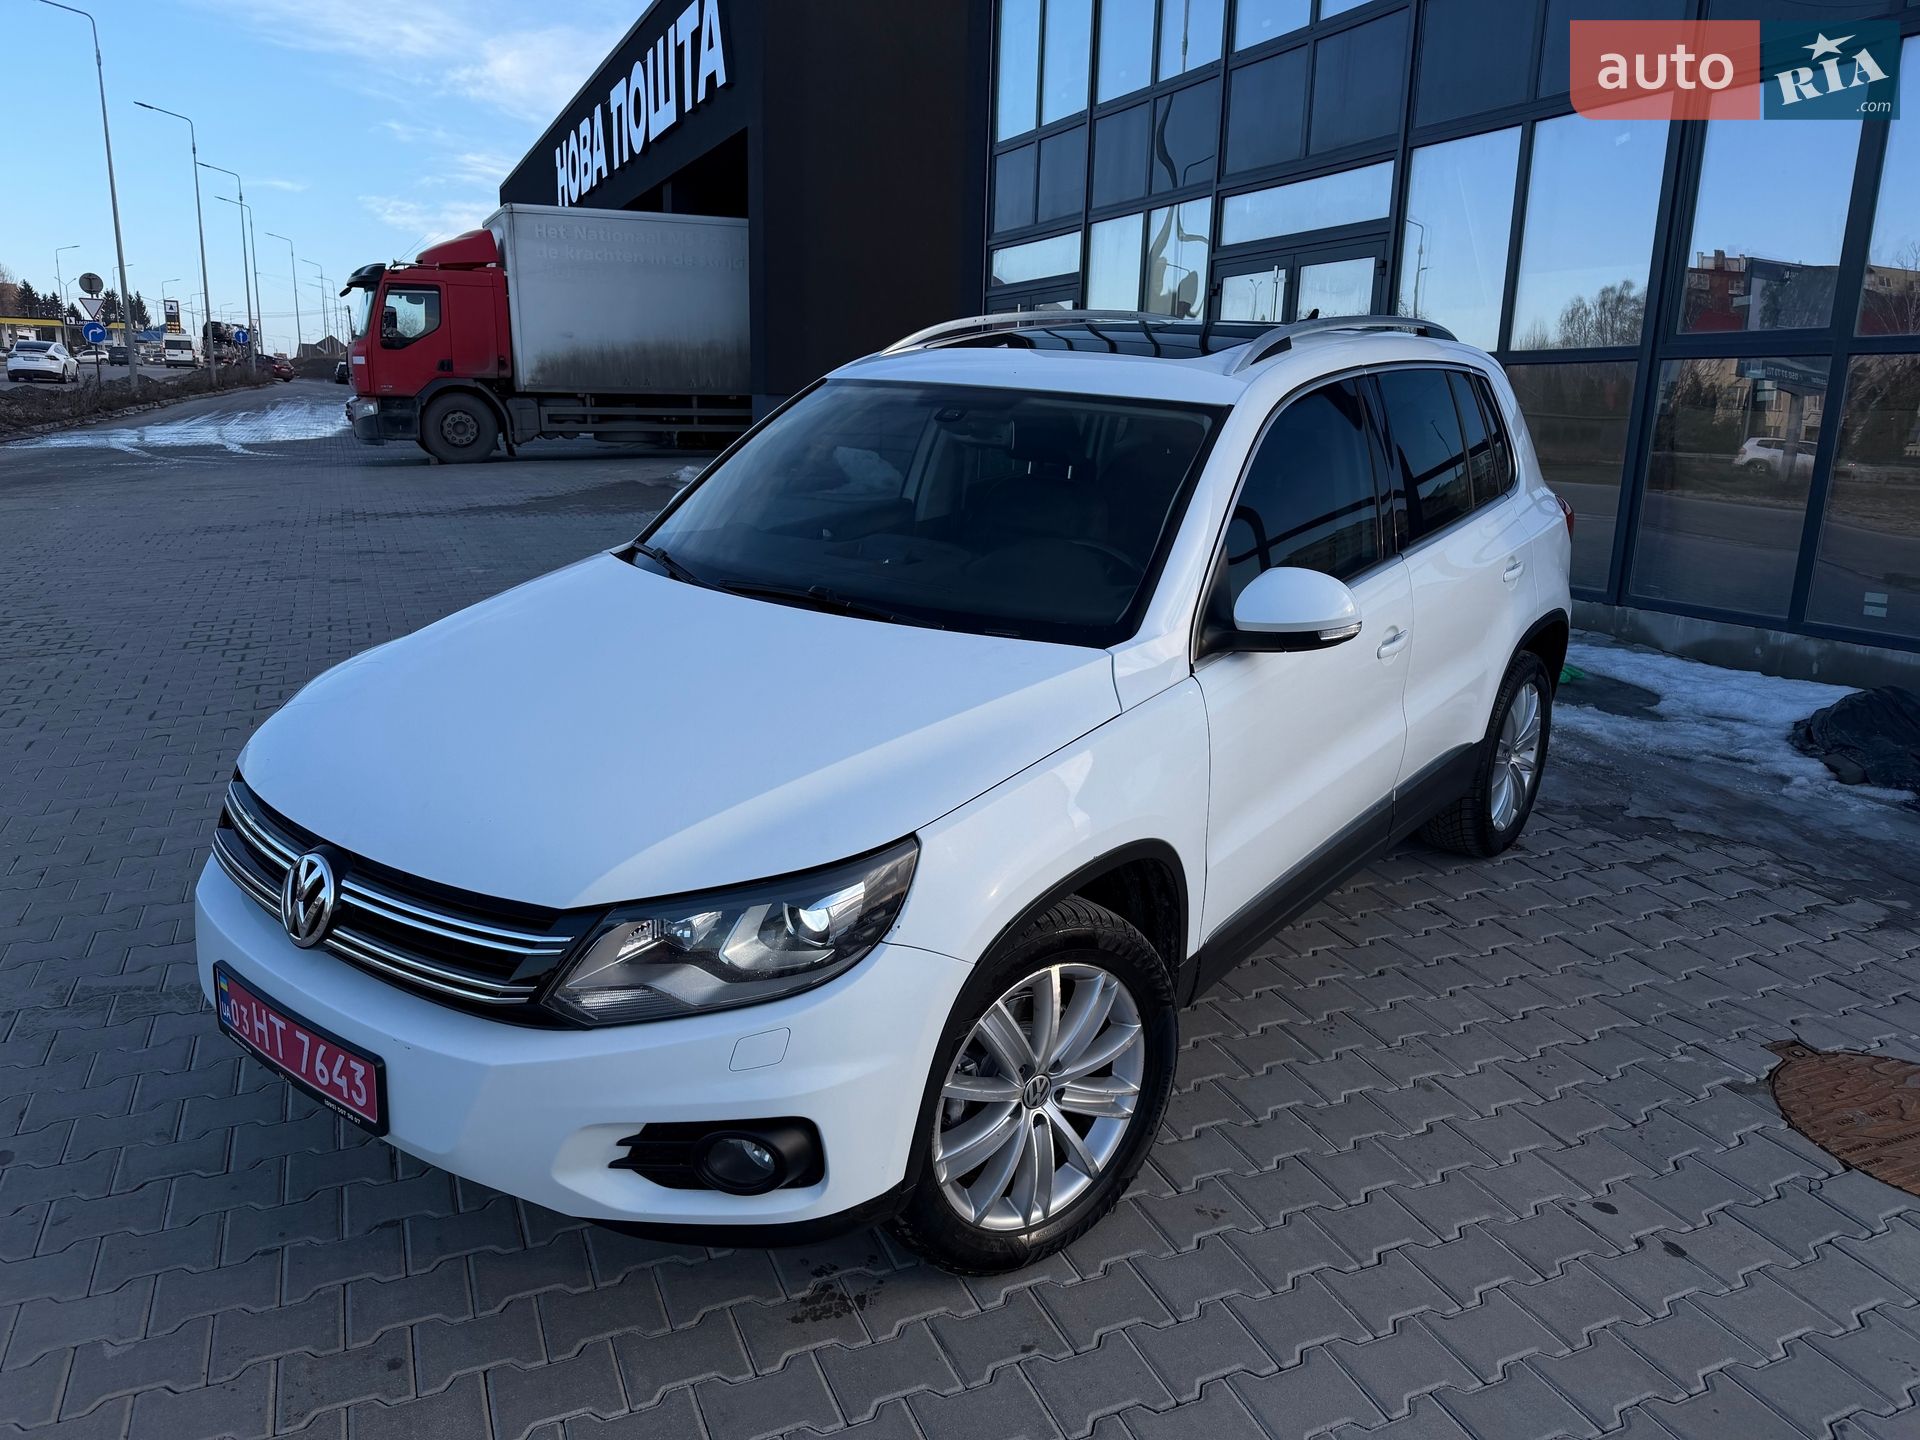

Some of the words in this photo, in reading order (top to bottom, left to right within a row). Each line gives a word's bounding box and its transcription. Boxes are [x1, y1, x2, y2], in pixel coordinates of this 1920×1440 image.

[556, 103, 608, 206] НОВА
[610, 0, 727, 170] ПОШТА
[534, 223, 567, 240] Het
[574, 225, 661, 246] Nationaal
[536, 244, 559, 261] de
[565, 244, 643, 264] krachten
[221, 1002, 231, 1021] UA
[295, 1030, 367, 1107] 7643
